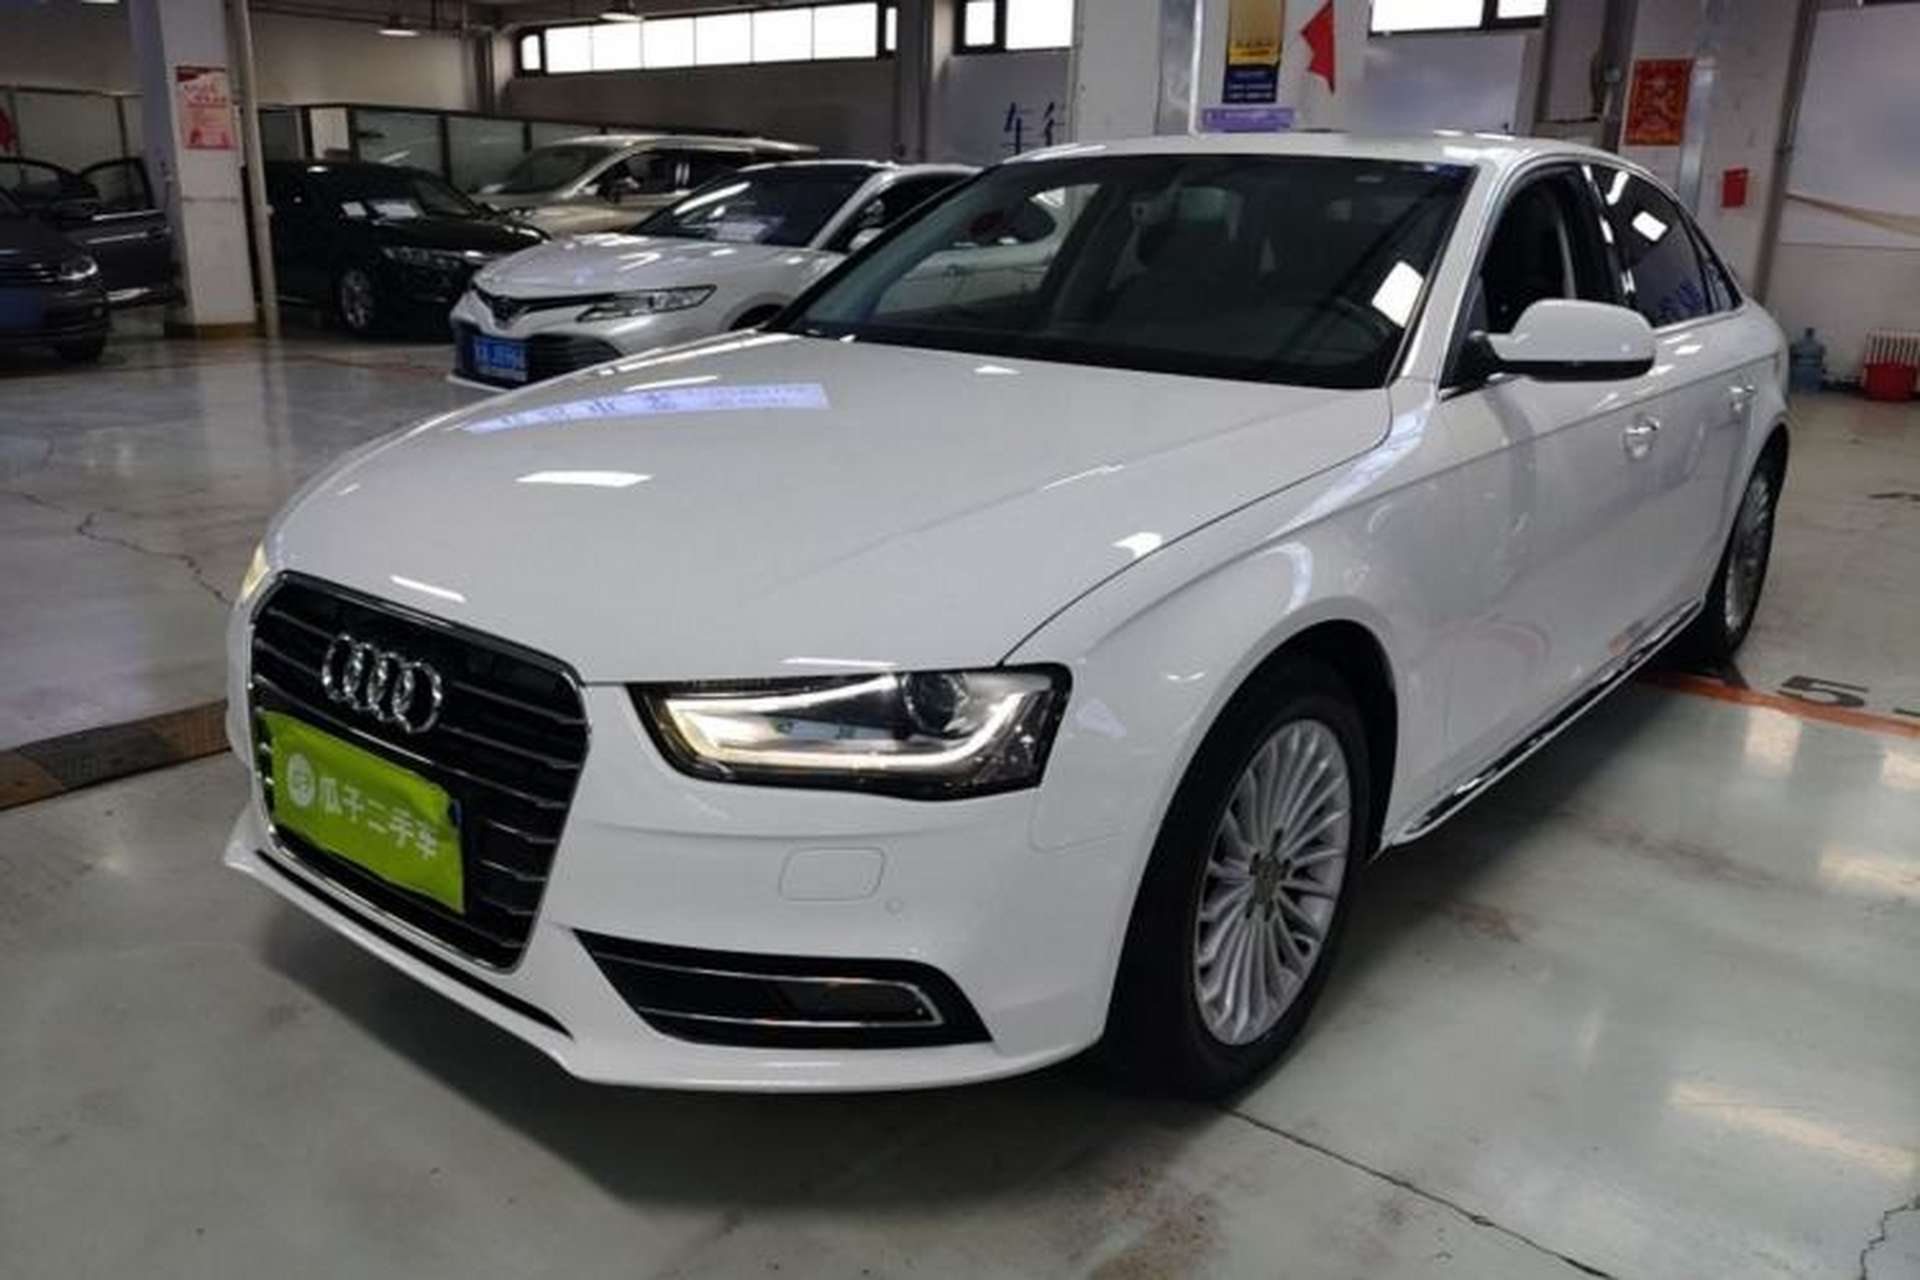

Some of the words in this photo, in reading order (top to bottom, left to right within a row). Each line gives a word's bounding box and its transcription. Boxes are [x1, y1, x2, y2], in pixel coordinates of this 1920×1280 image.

[318, 776, 439, 860] 瓜子二手车
